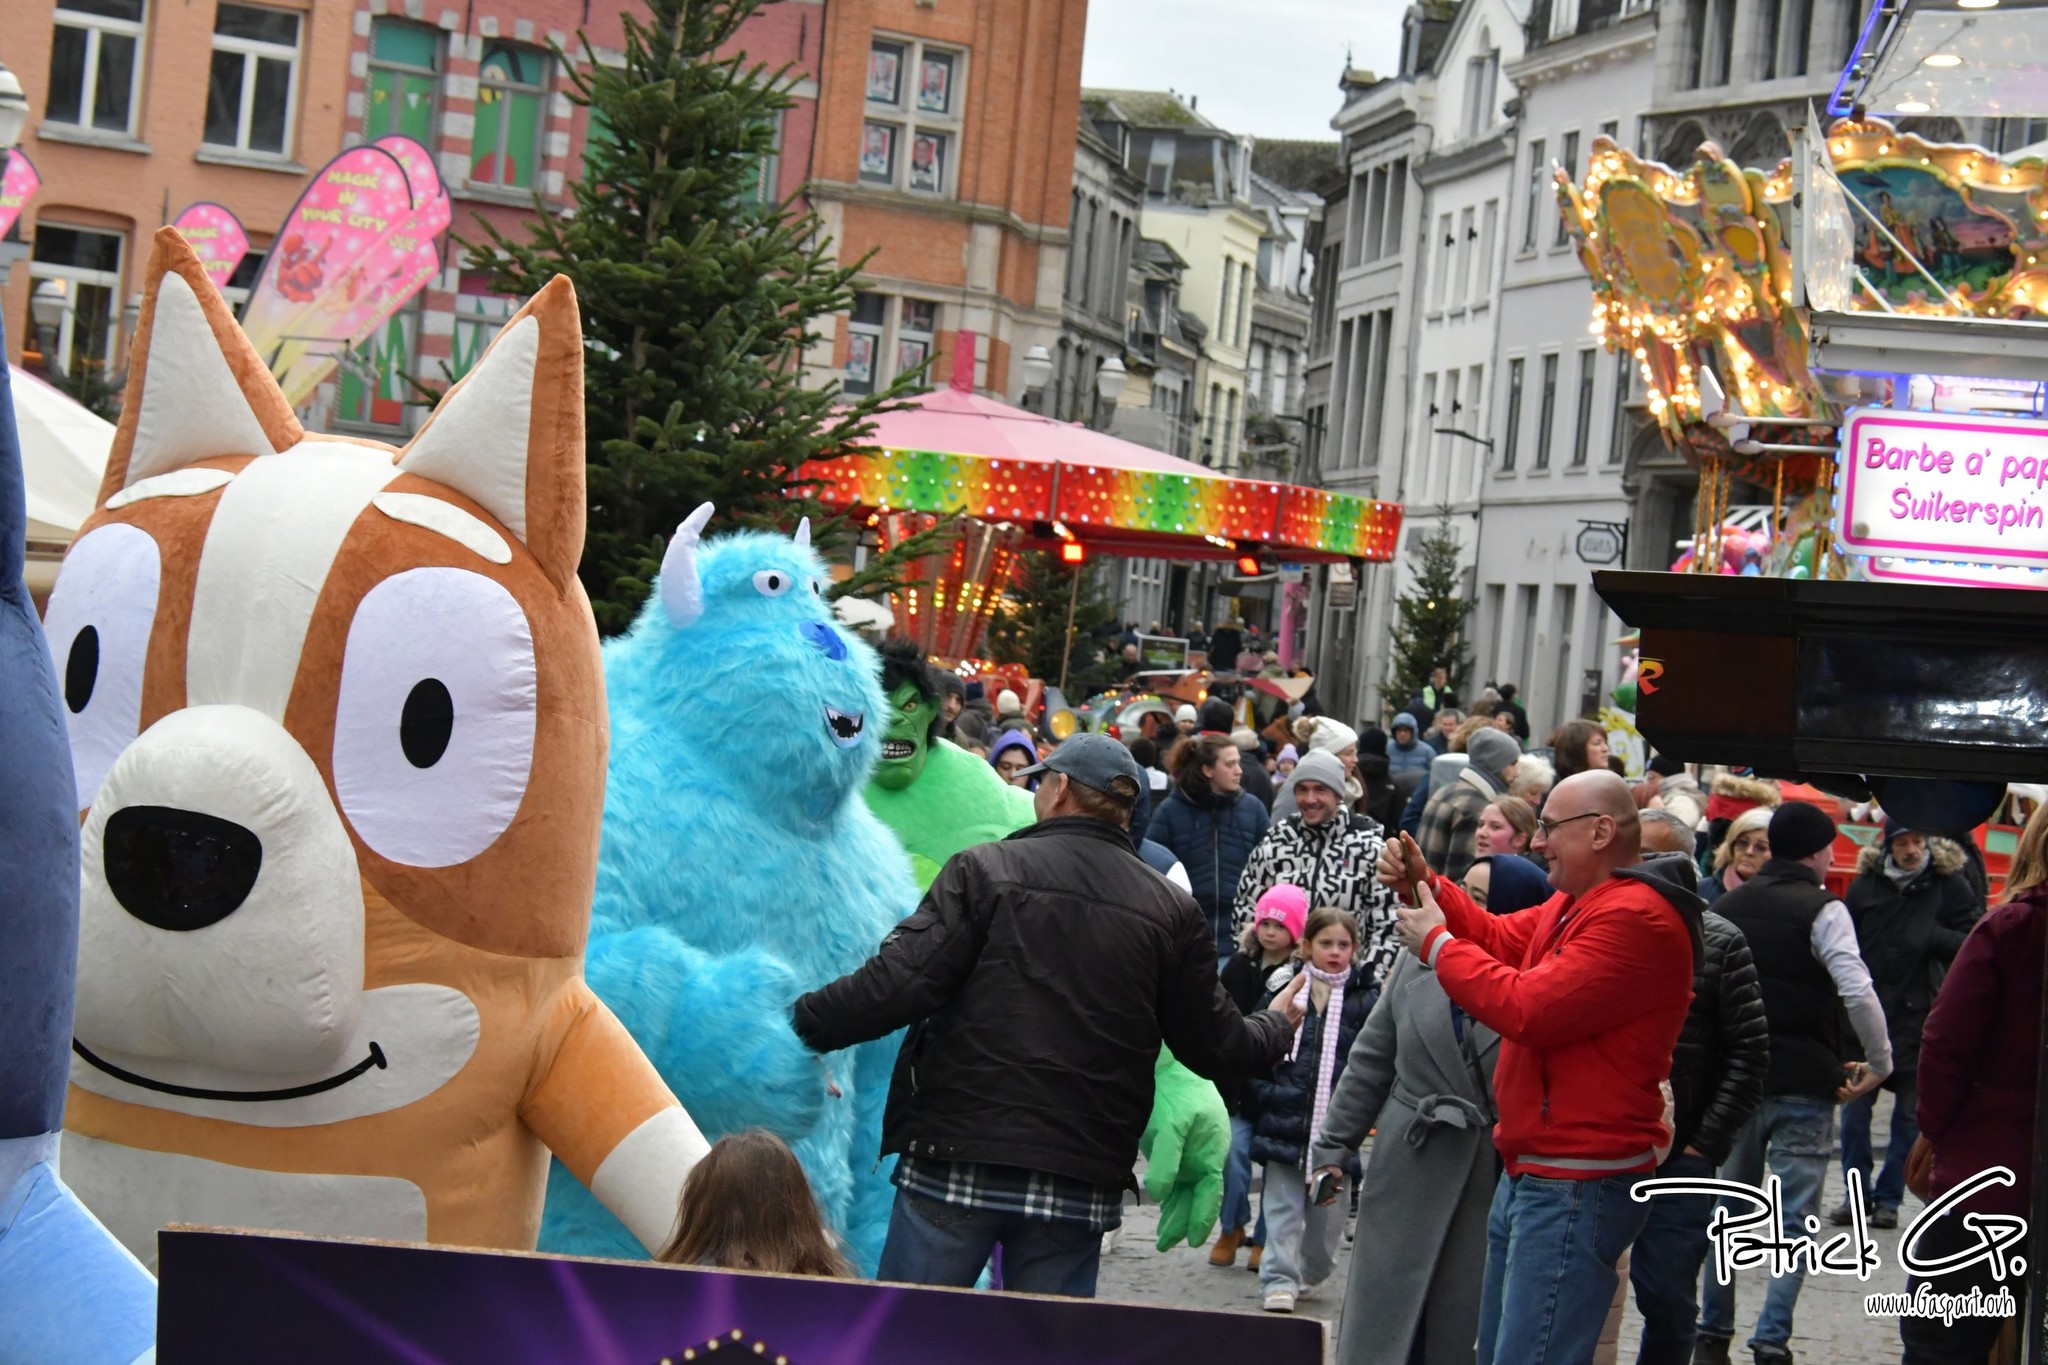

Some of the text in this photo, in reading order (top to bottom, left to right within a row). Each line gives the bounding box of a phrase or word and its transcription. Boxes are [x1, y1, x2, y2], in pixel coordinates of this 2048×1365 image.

[326, 170, 380, 190] MAGIC
[347, 213, 388, 234] CITY
[1865, 437, 1954, 474] Barbe
[1889, 487, 2044, 536] Suikerspin
